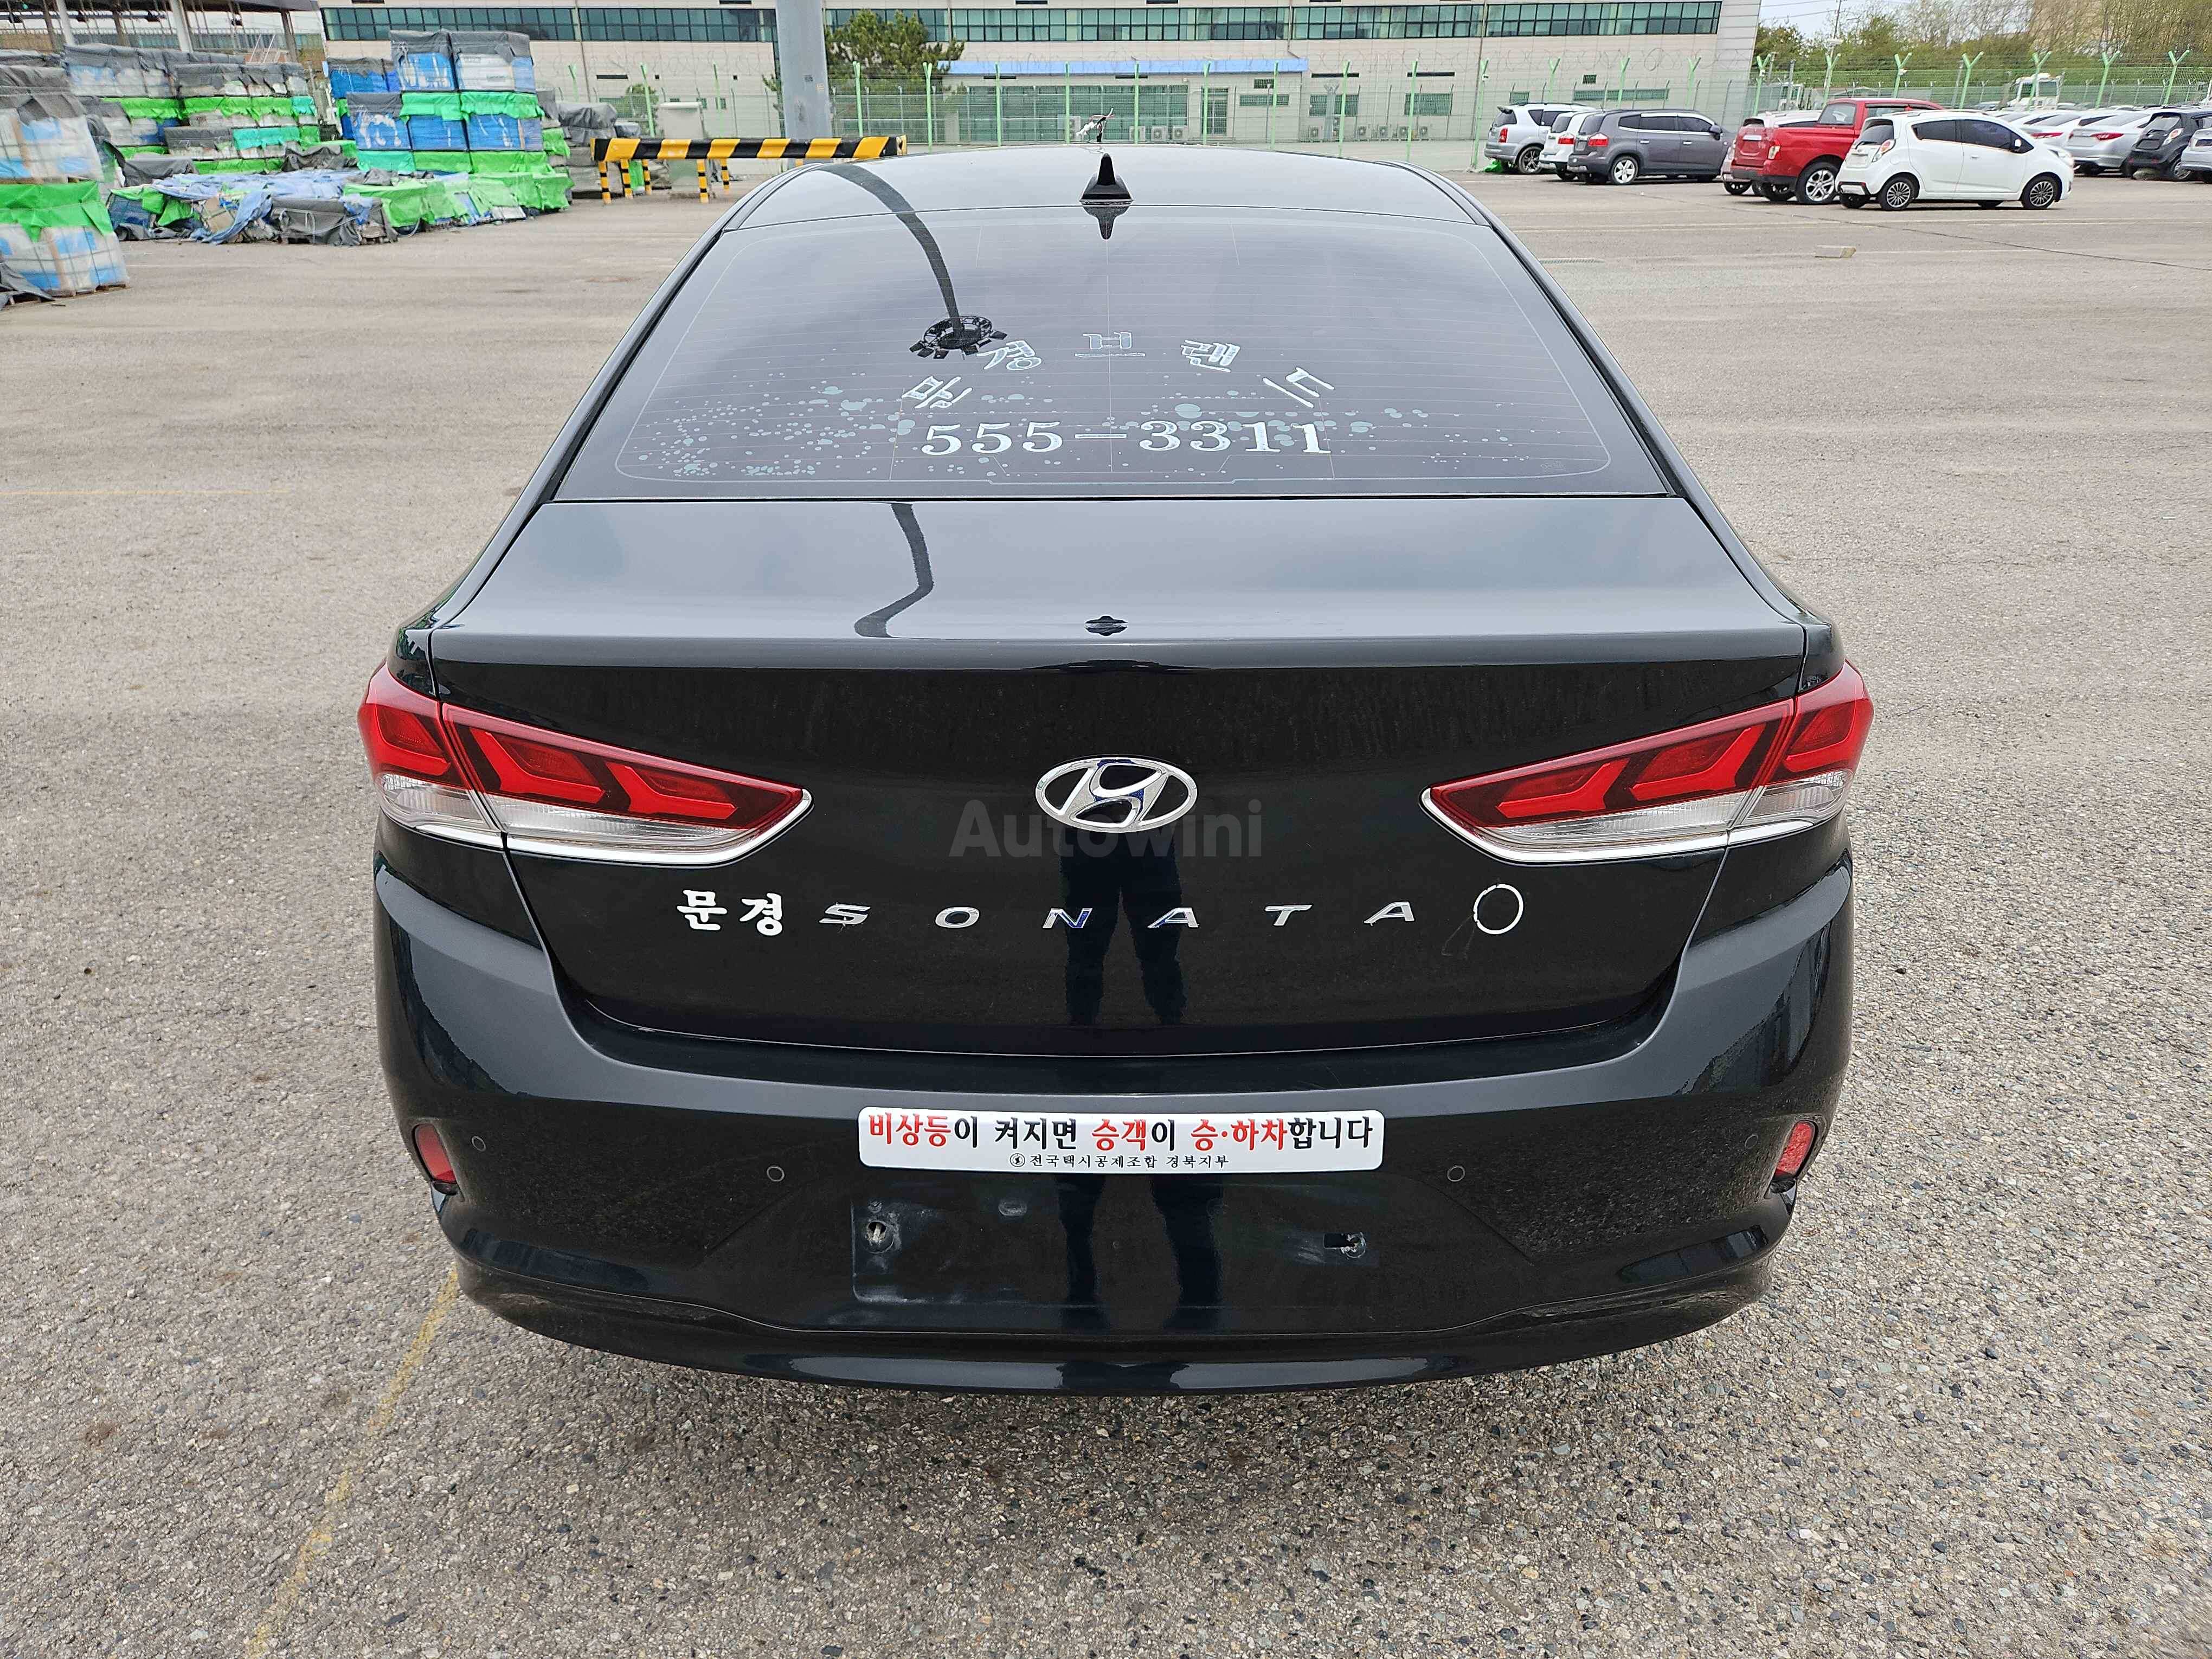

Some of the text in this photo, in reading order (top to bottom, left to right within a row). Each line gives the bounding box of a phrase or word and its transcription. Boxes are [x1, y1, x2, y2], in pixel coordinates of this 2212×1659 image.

[921, 420, 1332, 455] 555-3311
[676, 889, 783, 936] 문경
[818, 901, 1414, 930] SONATA
[869, 1112, 978, 1148] 비상등이
[994, 1117, 1077, 1150] 켜지면
[1091, 1118, 1175, 1152] 승객이
[1166, 1155, 1230, 1169] 경북지부
